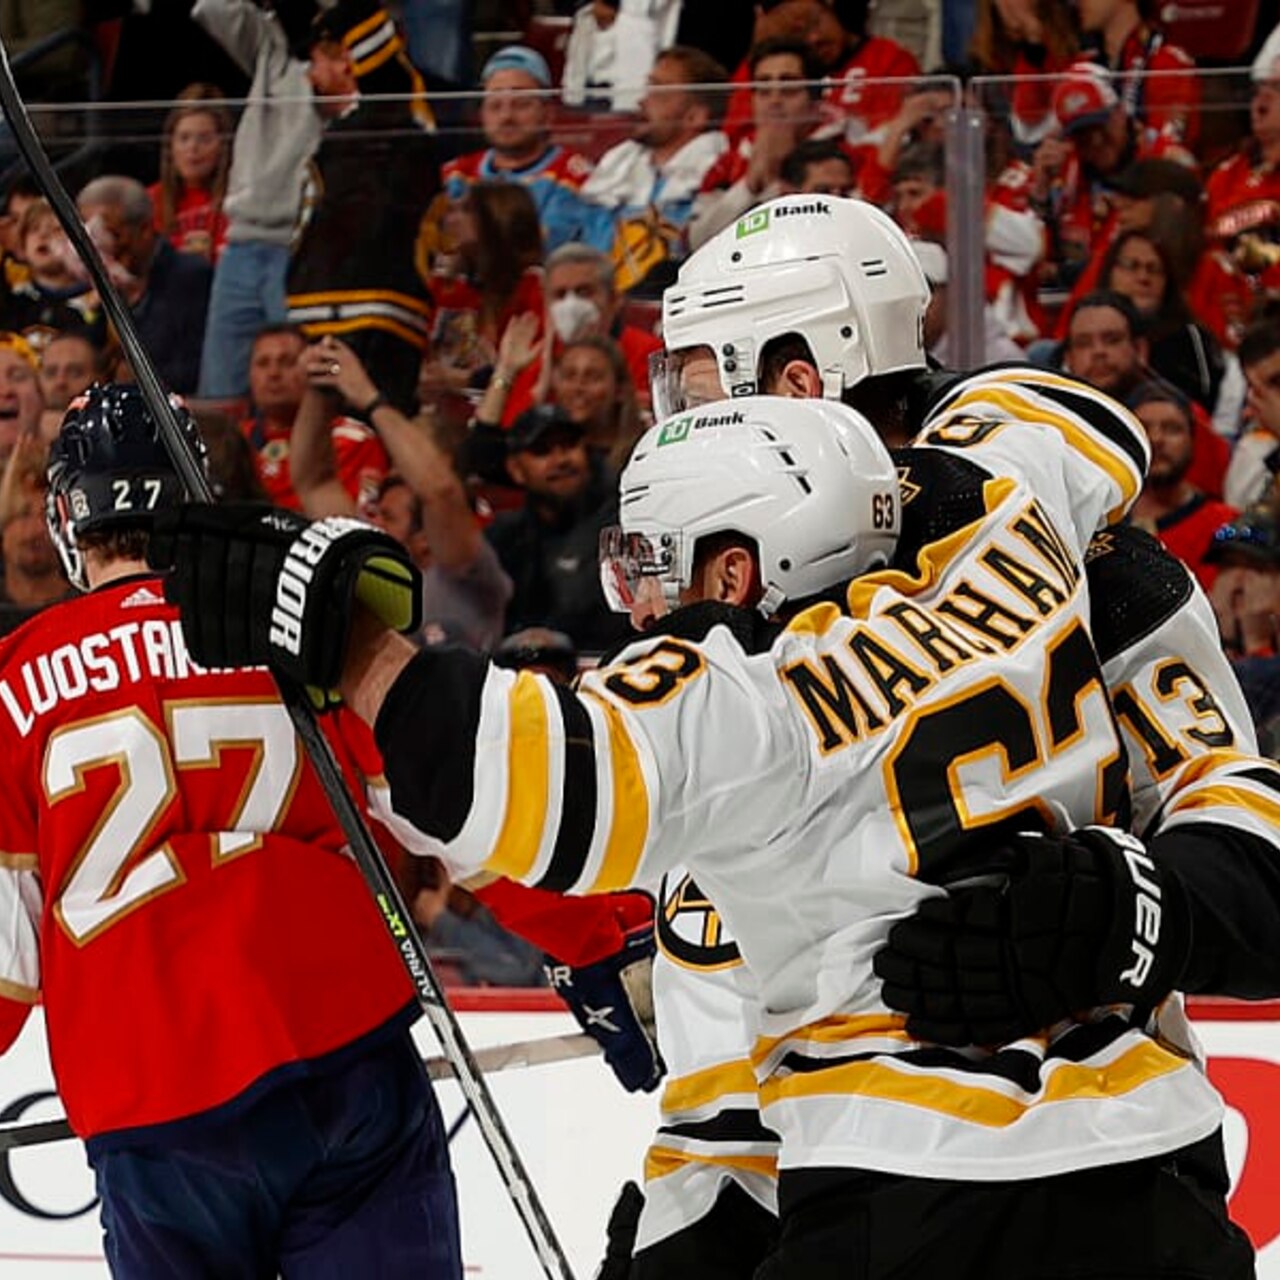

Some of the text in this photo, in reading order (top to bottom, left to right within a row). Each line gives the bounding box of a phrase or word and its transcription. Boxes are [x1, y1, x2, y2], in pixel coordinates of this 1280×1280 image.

[773, 202, 831, 218] Bank
[694, 411, 745, 429] Bank
[112, 479, 162, 511] 27
[872, 494, 895, 529] 63
[1113, 657, 1237, 783] 13
[42, 695, 303, 948] 27
